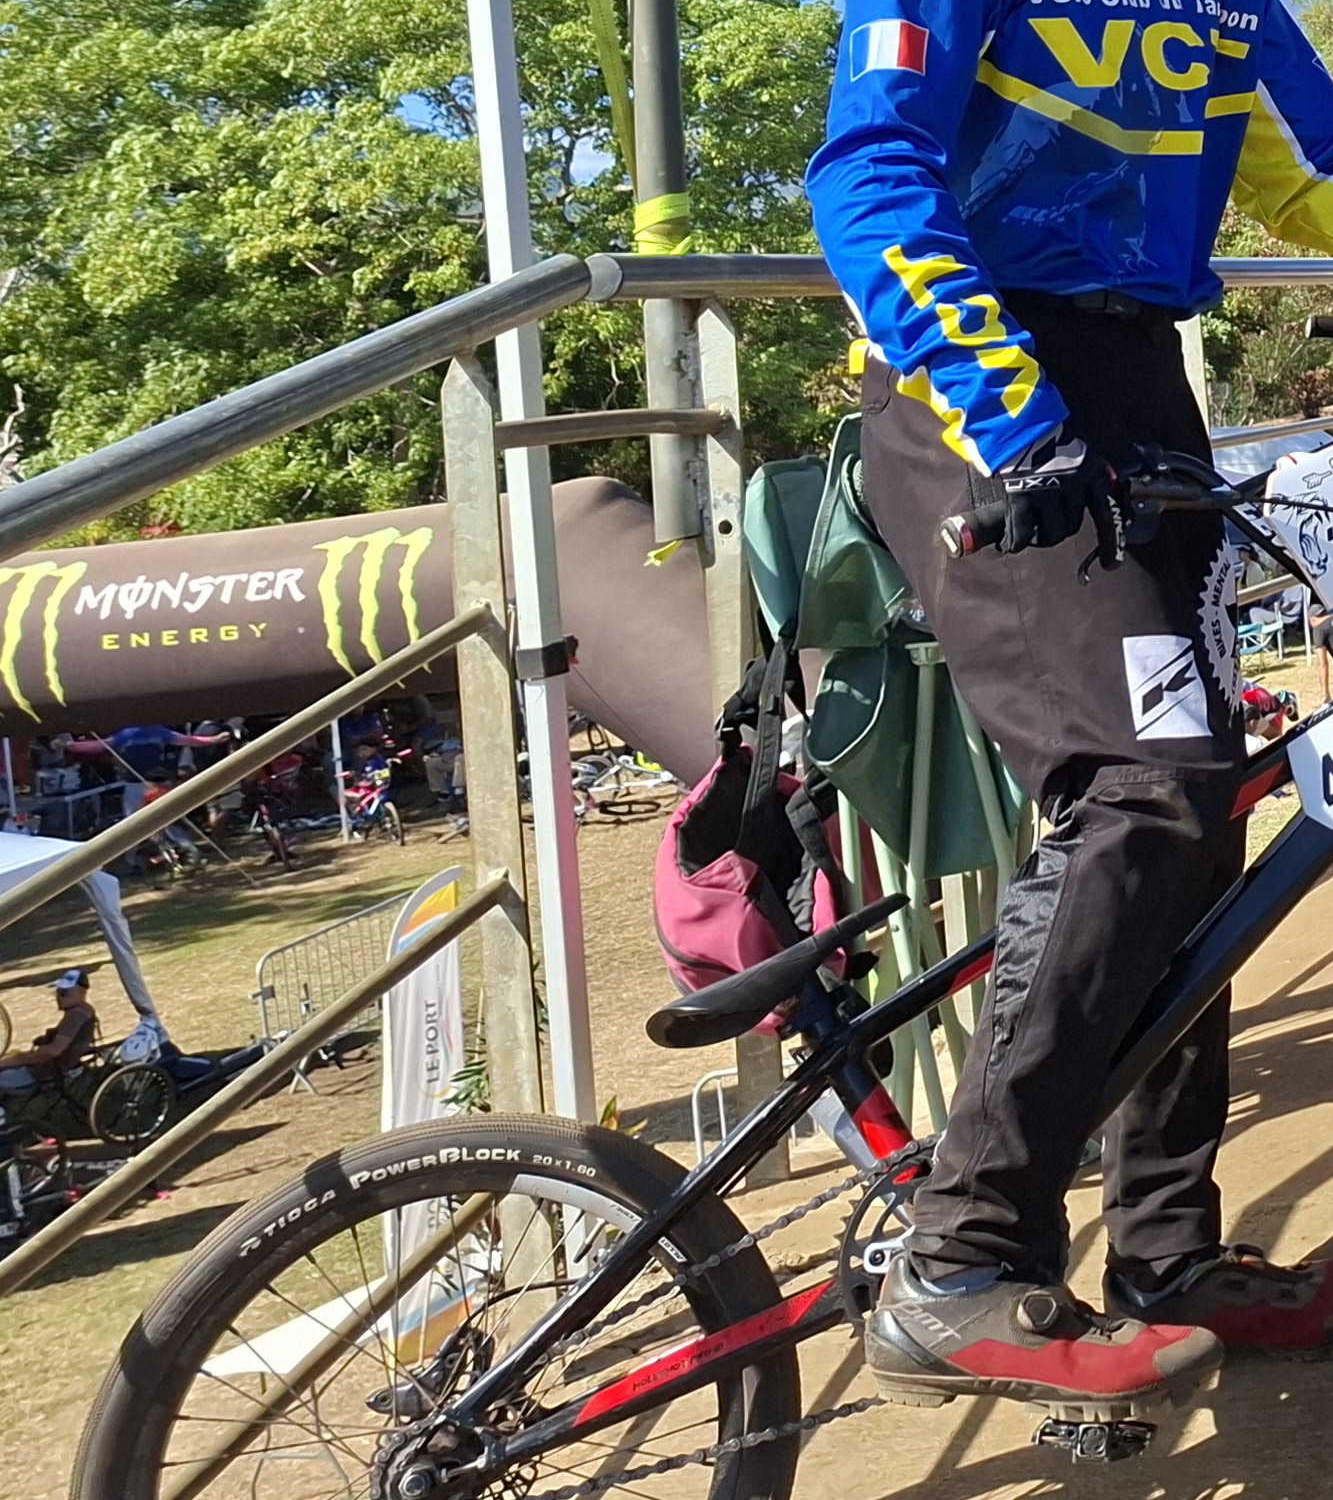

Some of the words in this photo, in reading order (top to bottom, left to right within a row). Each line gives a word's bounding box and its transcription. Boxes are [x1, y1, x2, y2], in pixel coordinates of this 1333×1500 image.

[75, 567, 305, 619] MONSTER
[102, 622, 268, 650] ENERGY
[263, 1189, 337, 1238] TIOGA
